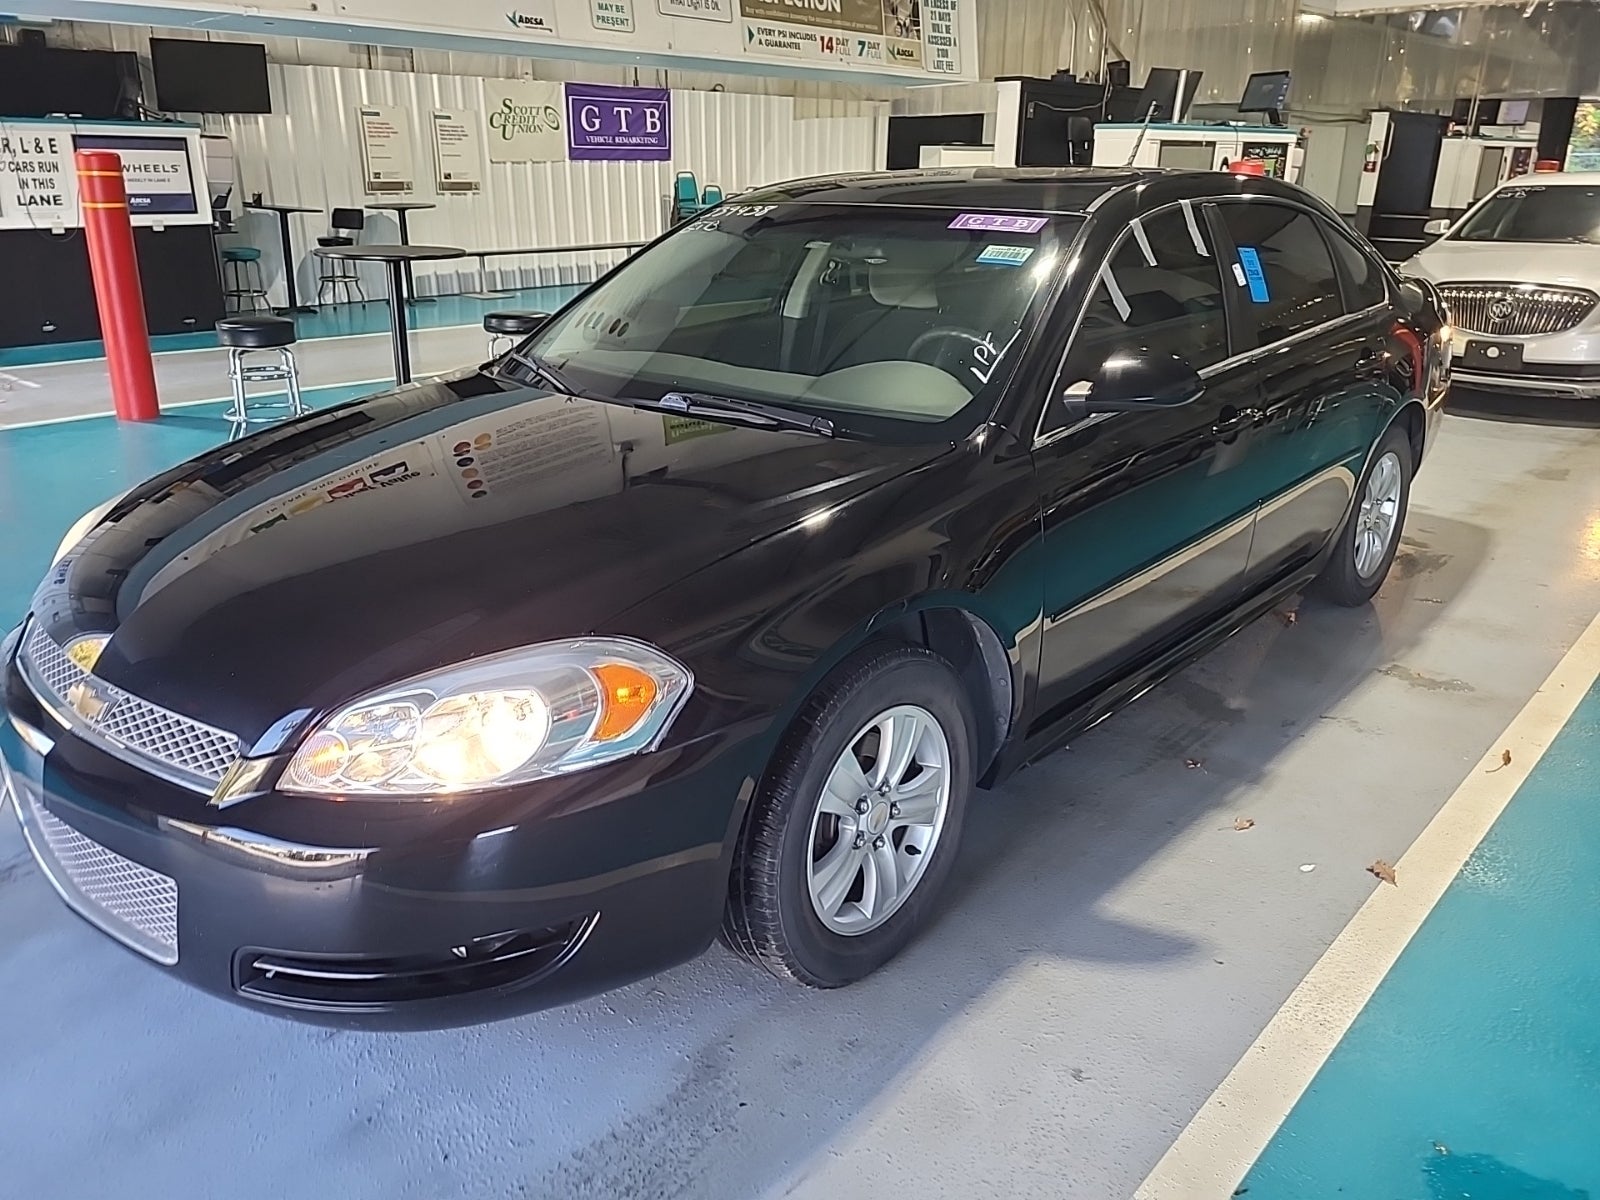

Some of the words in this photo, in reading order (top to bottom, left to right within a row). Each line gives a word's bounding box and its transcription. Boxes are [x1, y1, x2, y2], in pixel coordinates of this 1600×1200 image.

[598, 3, 613, 12] MAY
[615, 5, 626, 14] BE
[518, 14, 545, 26] ADESA
[596, 15, 630, 27] PRESENT
[757, 27, 776, 38] EVERY
[777, 30, 788, 39] PSI
[788, 32, 818, 42] INCLUDES
[758, 38, 763, 46] A
[765, 39, 802, 51] GUARANTEE
[820, 35, 834, 54] 14
[835, 38, 850, 47] DAY
[857, 40, 867, 57] 7
[867, 41, 881, 51] DAY
[835, 46, 851, 57] FULL
[867, 49, 882, 60] FULL
[933, 60, 945, 71] LATE
[946, 60, 954, 71] FEE
[501, 98, 542, 116] SCOTT
[489, 112, 538, 129] CREDIT
[501, 123, 545, 141] UNION
[19, 137, 30, 154] L
[34, 137, 45, 154] &
[48, 138, 59, 154] E
[586, 135, 613, 144] VEHICLE
[615, 136, 659, 145] REMARKETING
[8, 161, 36, 173] CARS
[37, 161, 60, 173] RUN
[19, 178, 30, 190] IN
[31, 178, 56, 190] THIS
[16, 194, 64, 206] LANE
